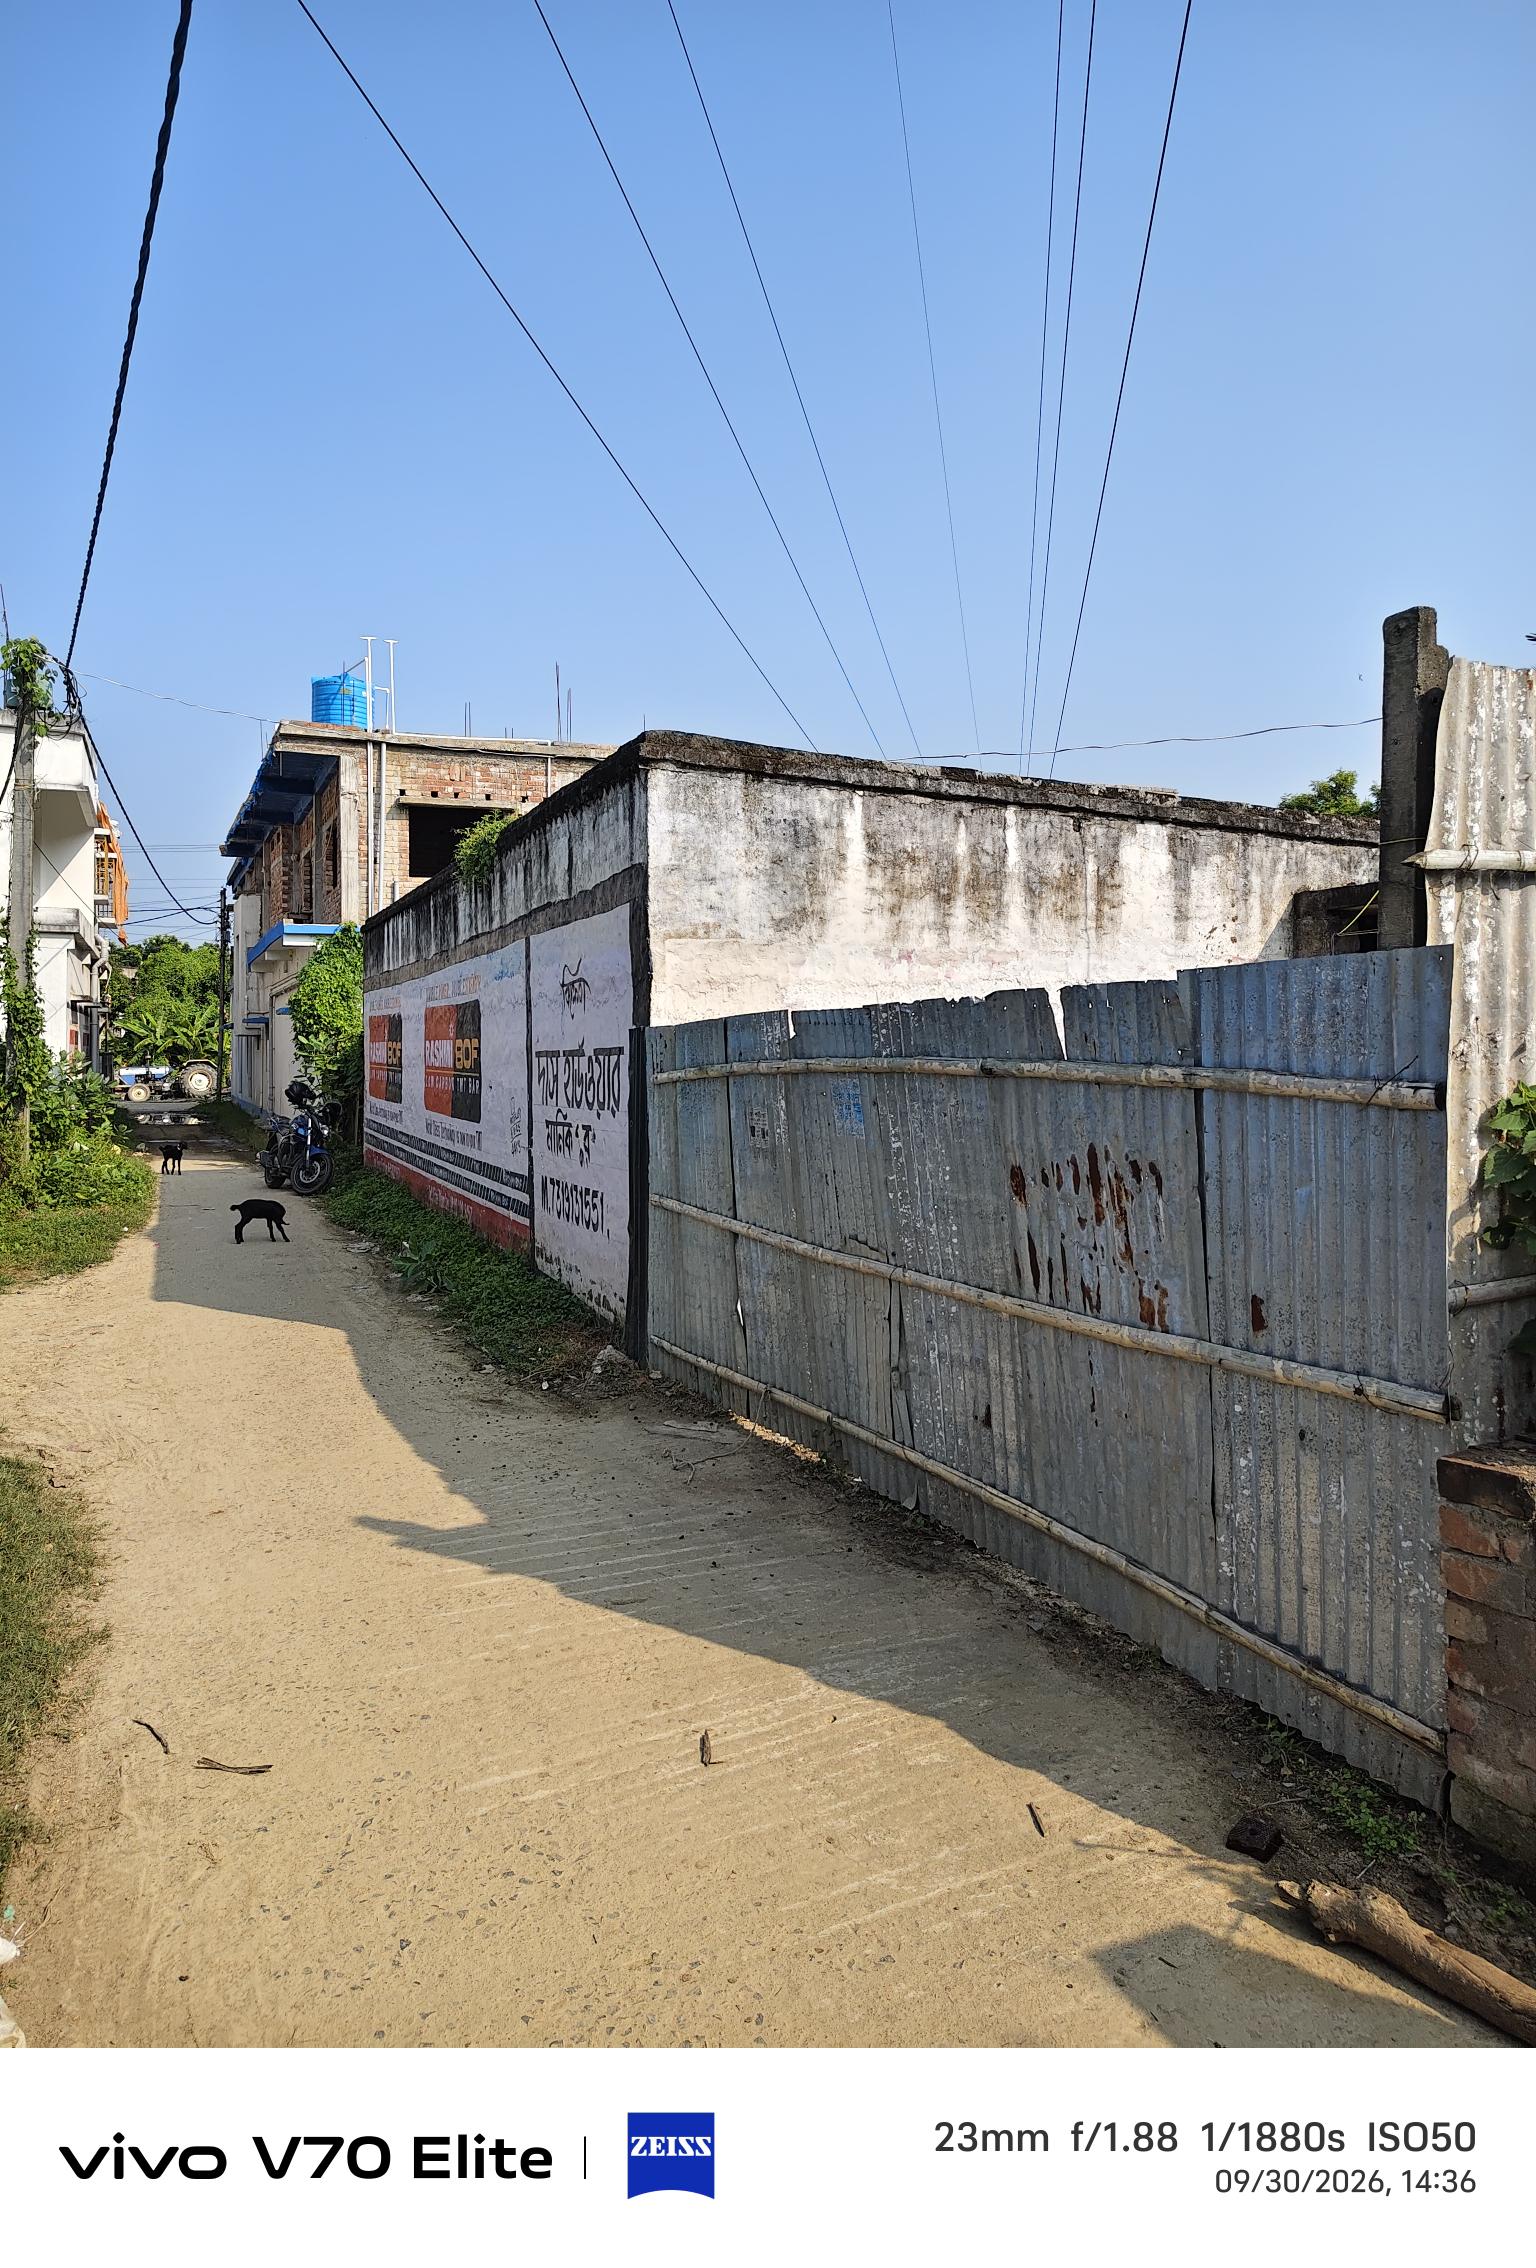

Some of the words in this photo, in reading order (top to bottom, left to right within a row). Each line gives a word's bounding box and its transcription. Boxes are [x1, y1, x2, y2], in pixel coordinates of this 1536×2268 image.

[387, 1040, 402, 1065] BOF
[425, 1039, 454, 1068] RASHMI
[455, 1038, 480, 1069] BOF
[469, 1078, 480, 1095] BAR
[535, 1049, 560, 1106] দাস
